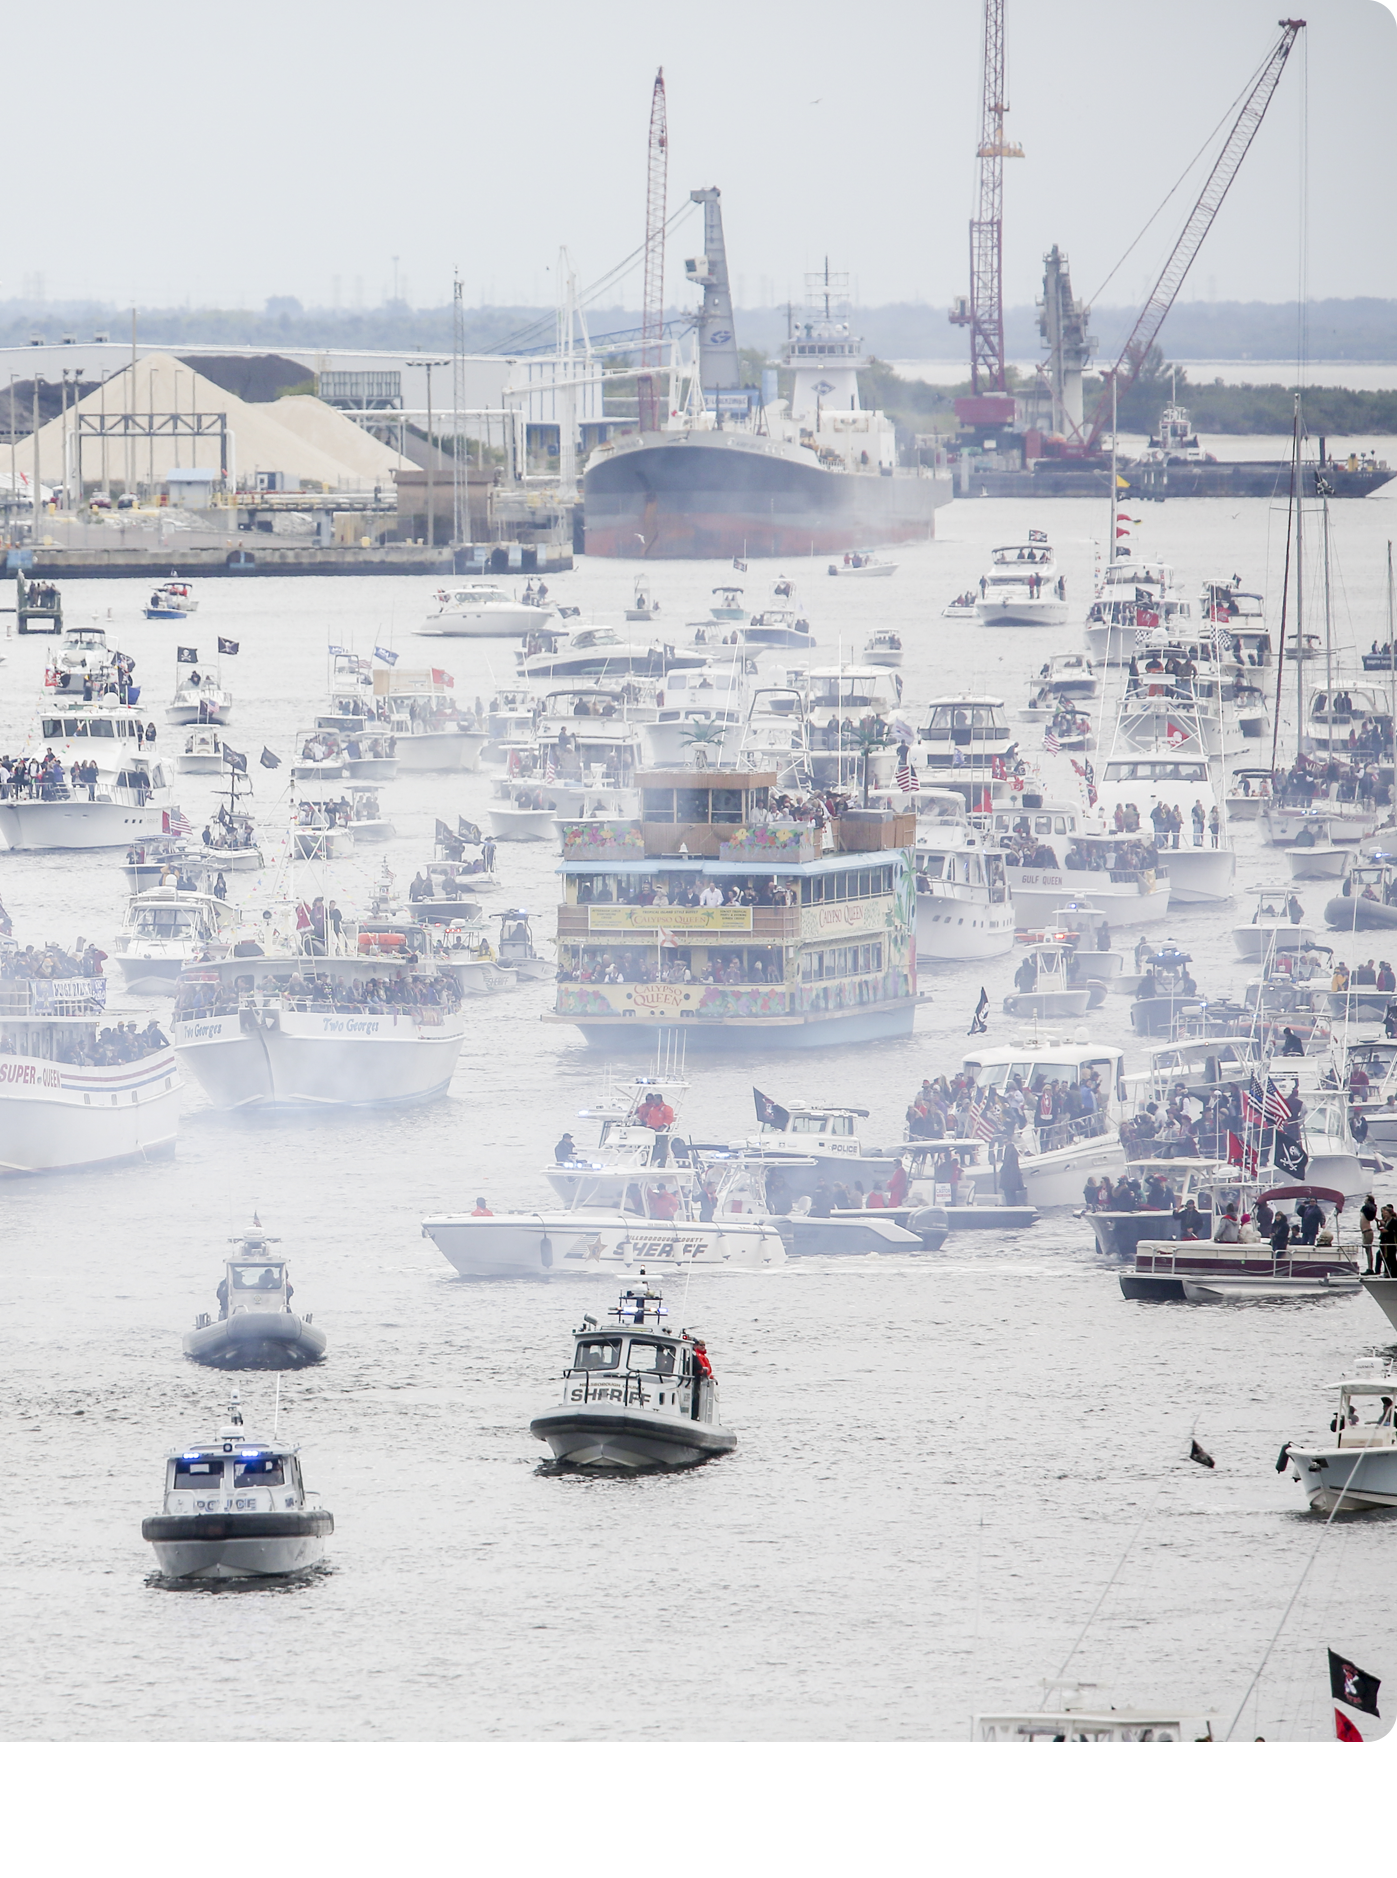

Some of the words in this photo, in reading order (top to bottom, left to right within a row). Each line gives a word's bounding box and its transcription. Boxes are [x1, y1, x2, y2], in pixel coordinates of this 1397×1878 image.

[1022, 875, 1039, 883] GULF
[1043, 876, 1062, 885] QUEEN
[634, 915, 672, 925] CALYPSO
[675, 915, 706, 925] QUEEN
[819, 908, 842, 928] CALYPSO
[844, 905, 864, 926] QUEEN
[634, 984, 682, 996] CALYPSO
[633, 993, 683, 1008] QUEEN
[184, 1025, 193, 1039] Two
[194, 1023, 222, 1038] Georges
[322, 1017, 344, 1032] Two
[346, 1018, 379, 1035] Georges
[43, 1067, 61, 1088] QUEEN
[831, 1144, 857, 1153] POLICE
[613, 1241, 708, 1258] SHERFF
